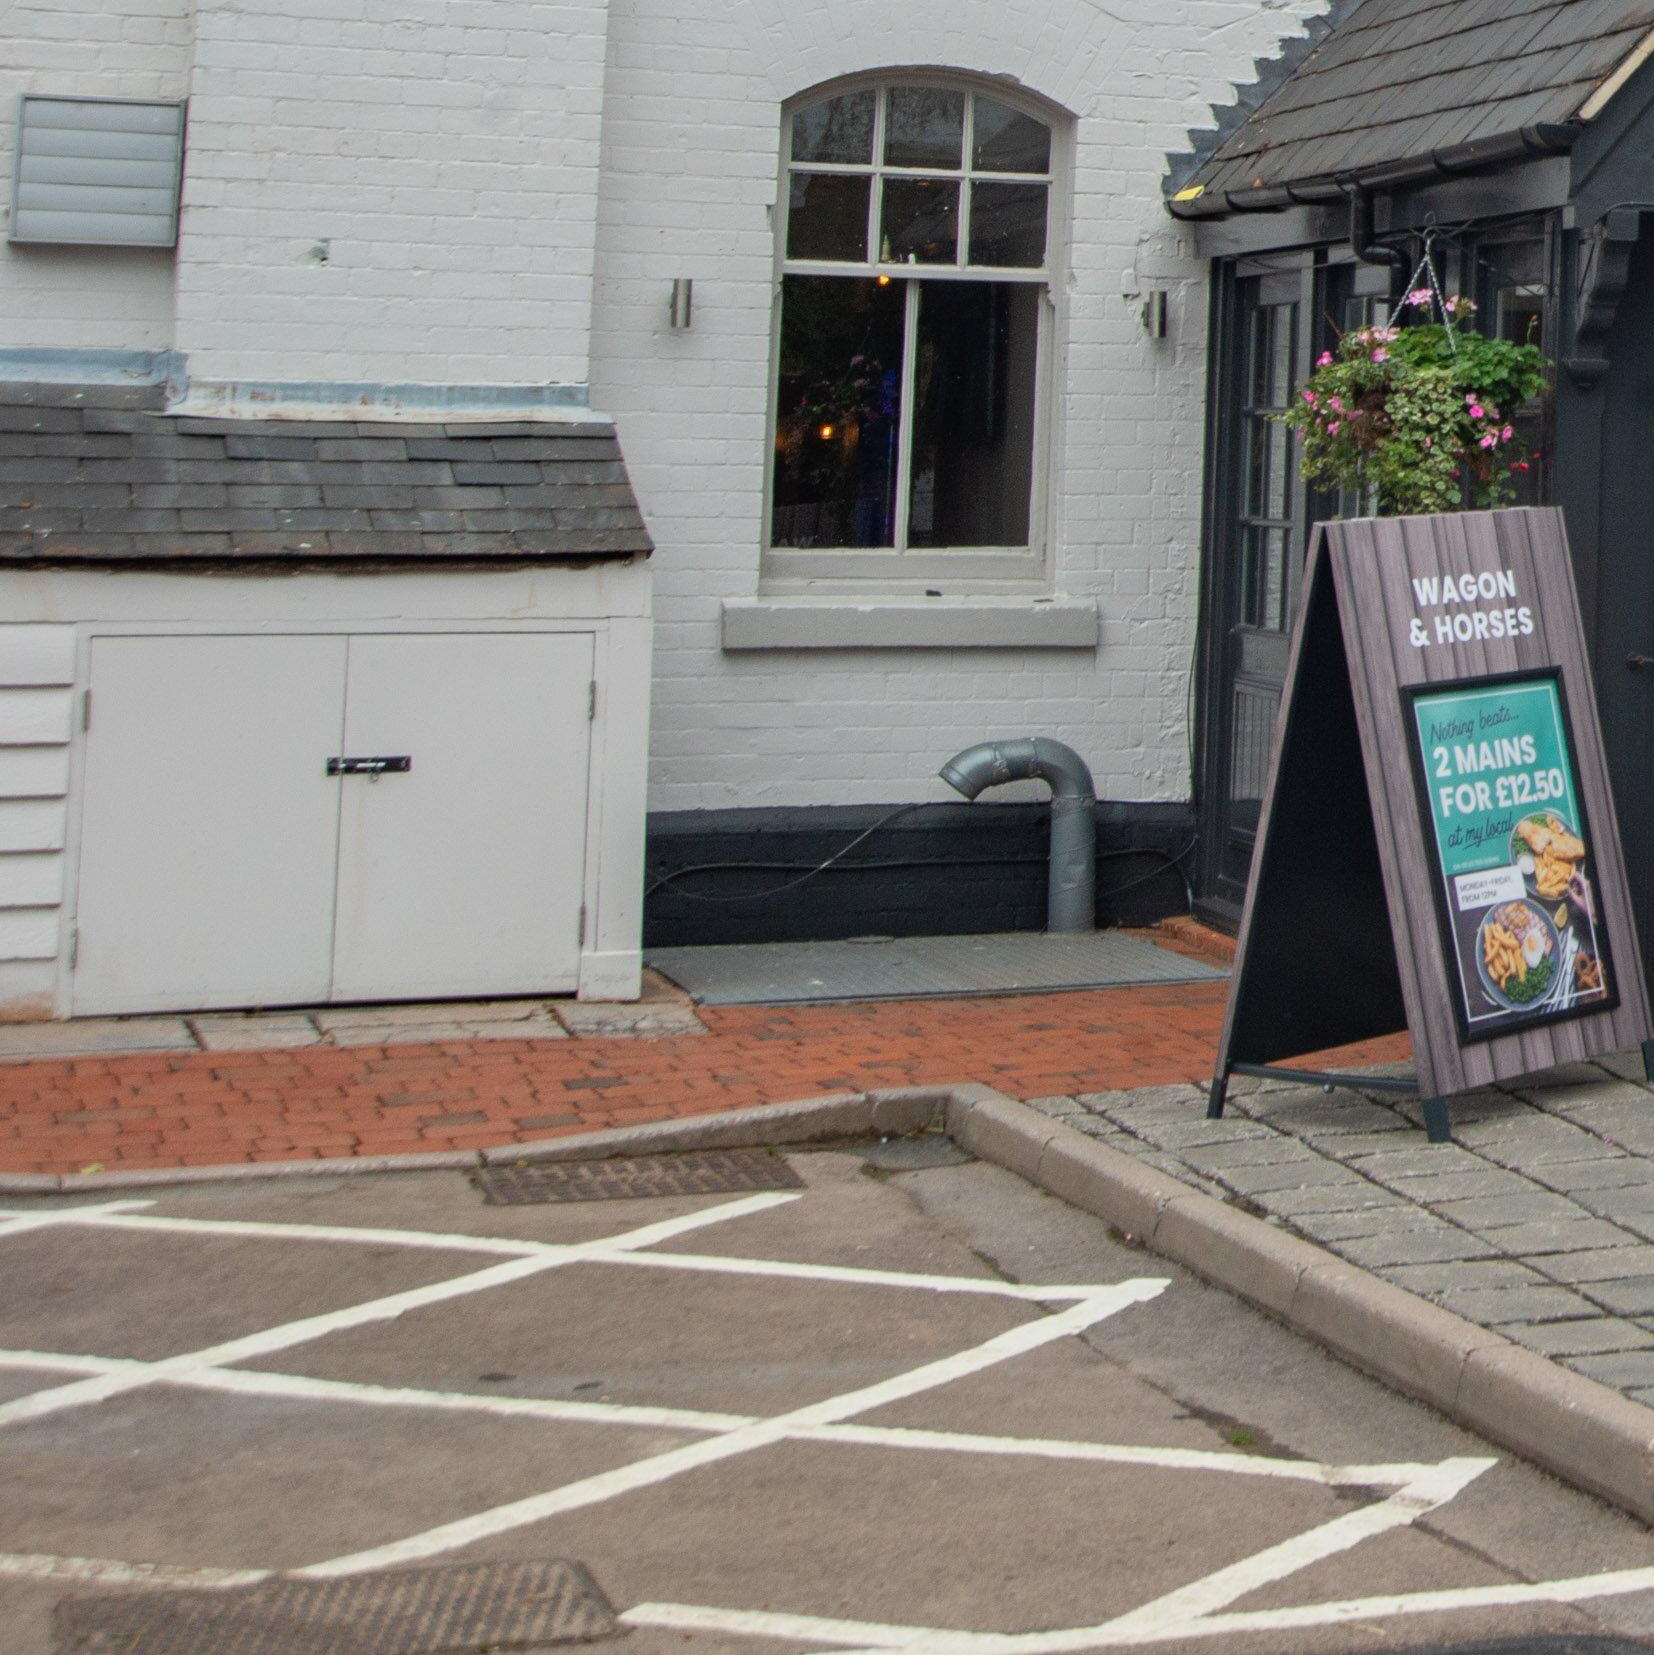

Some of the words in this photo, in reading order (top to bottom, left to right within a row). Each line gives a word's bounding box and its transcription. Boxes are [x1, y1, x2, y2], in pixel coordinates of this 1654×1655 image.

[1412, 569, 1517, 607] WAGON
[1409, 617, 1431, 647] &
[1434, 606, 1534, 645] HORSES
[1430, 716, 1475, 744] Nothing
[1433, 745, 1452, 778] 2
[1454, 734, 1537, 775] MAINS
[1438, 780, 1493, 818] FOR
[1495, 767, 1565, 809] £12.50
[1448, 824, 1463, 848] at
[1465, 827, 1482, 848] my
[1485, 811, 1514, 838] local
